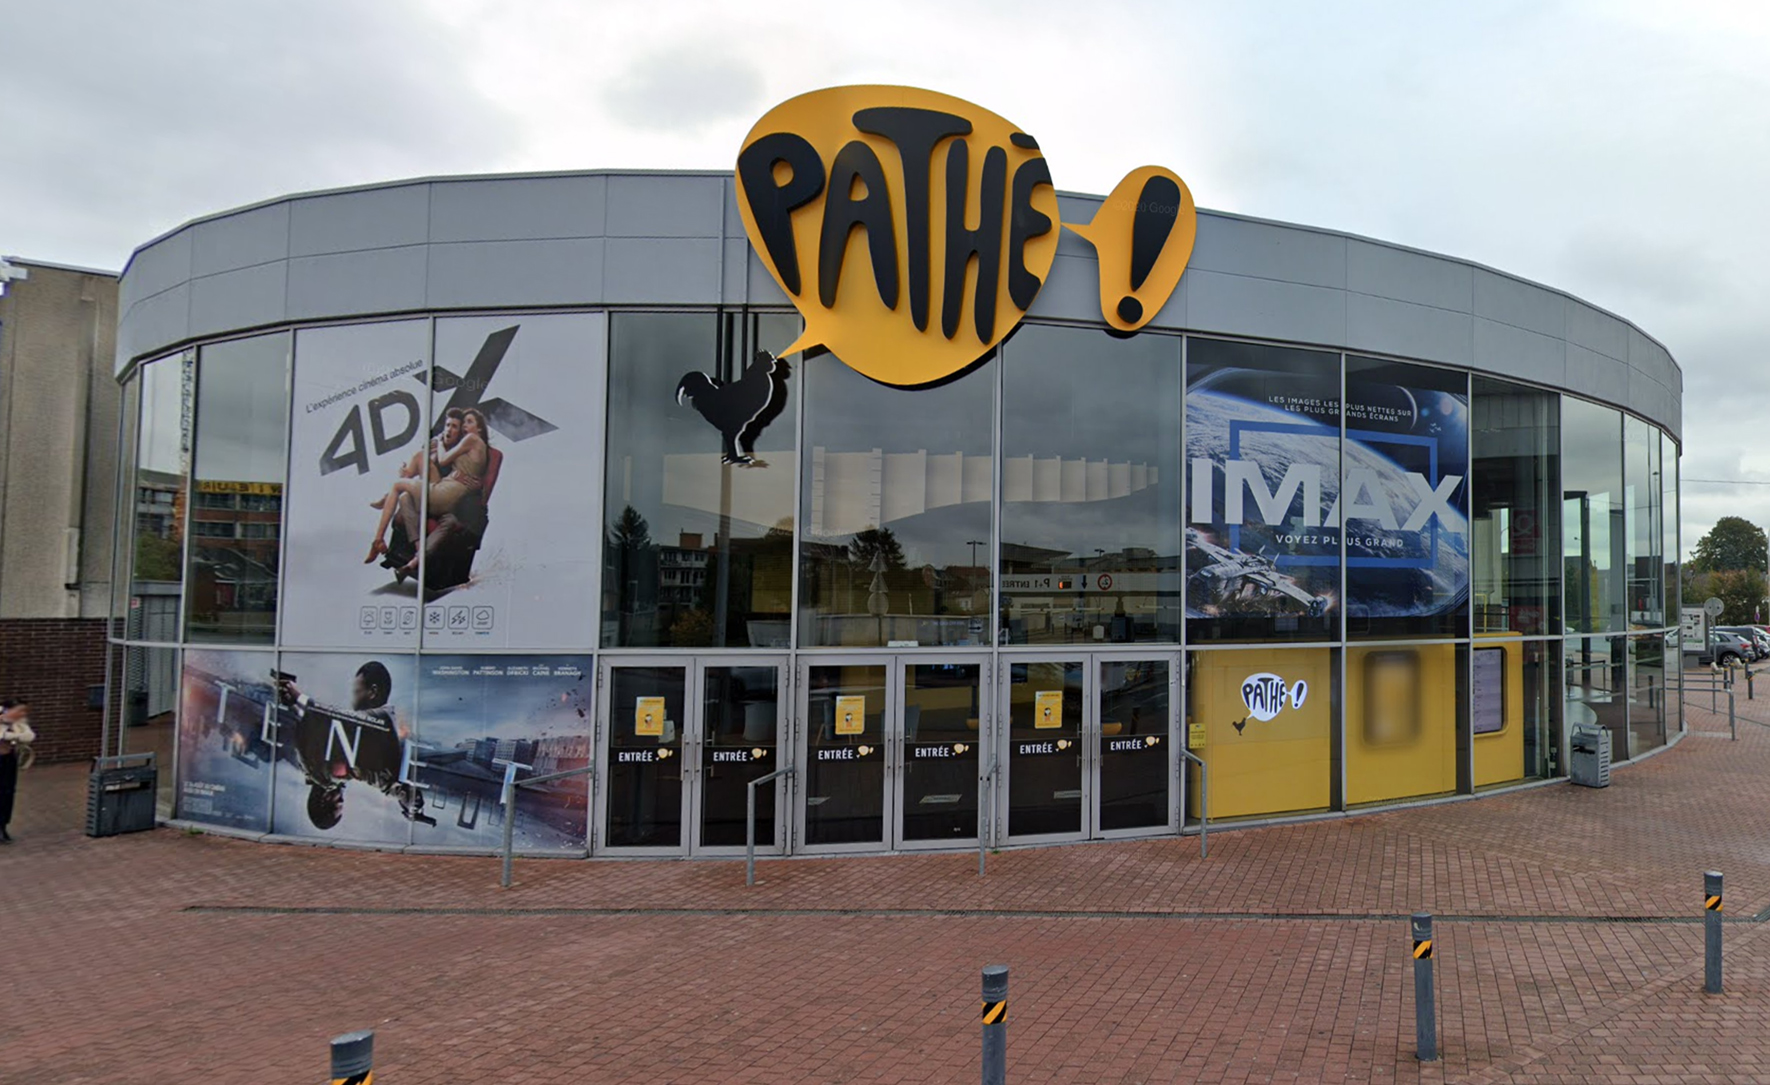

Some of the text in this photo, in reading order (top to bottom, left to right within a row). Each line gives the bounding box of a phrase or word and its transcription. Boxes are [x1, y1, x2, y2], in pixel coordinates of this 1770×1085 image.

[305, 386, 357, 413] L'expérience
[358, 372, 389, 392] cinéma
[389, 359, 424, 379] absolue
[319, 324, 559, 476] 4DX
[1268, 396, 1412, 417] LES IMAGES LES PLUS NETTES SUR
[1284, 404, 1399, 422] LES PLUS GRANDS ÉCRANS
[1191, 458, 1469, 532] IMAX
[1275, 534, 1404, 549] VOYEZ PLUS GRAND
[915, 745, 949, 758] ENTRÉE
[1019, 742, 1053, 755] ENTRÉE
[1110, 739, 1142, 751] ENTRÉE
[618, 750, 653, 762] ENTRÉE
[713, 750, 748, 762] ENTRÉE
[818, 748, 854, 760] ENTRÉE
